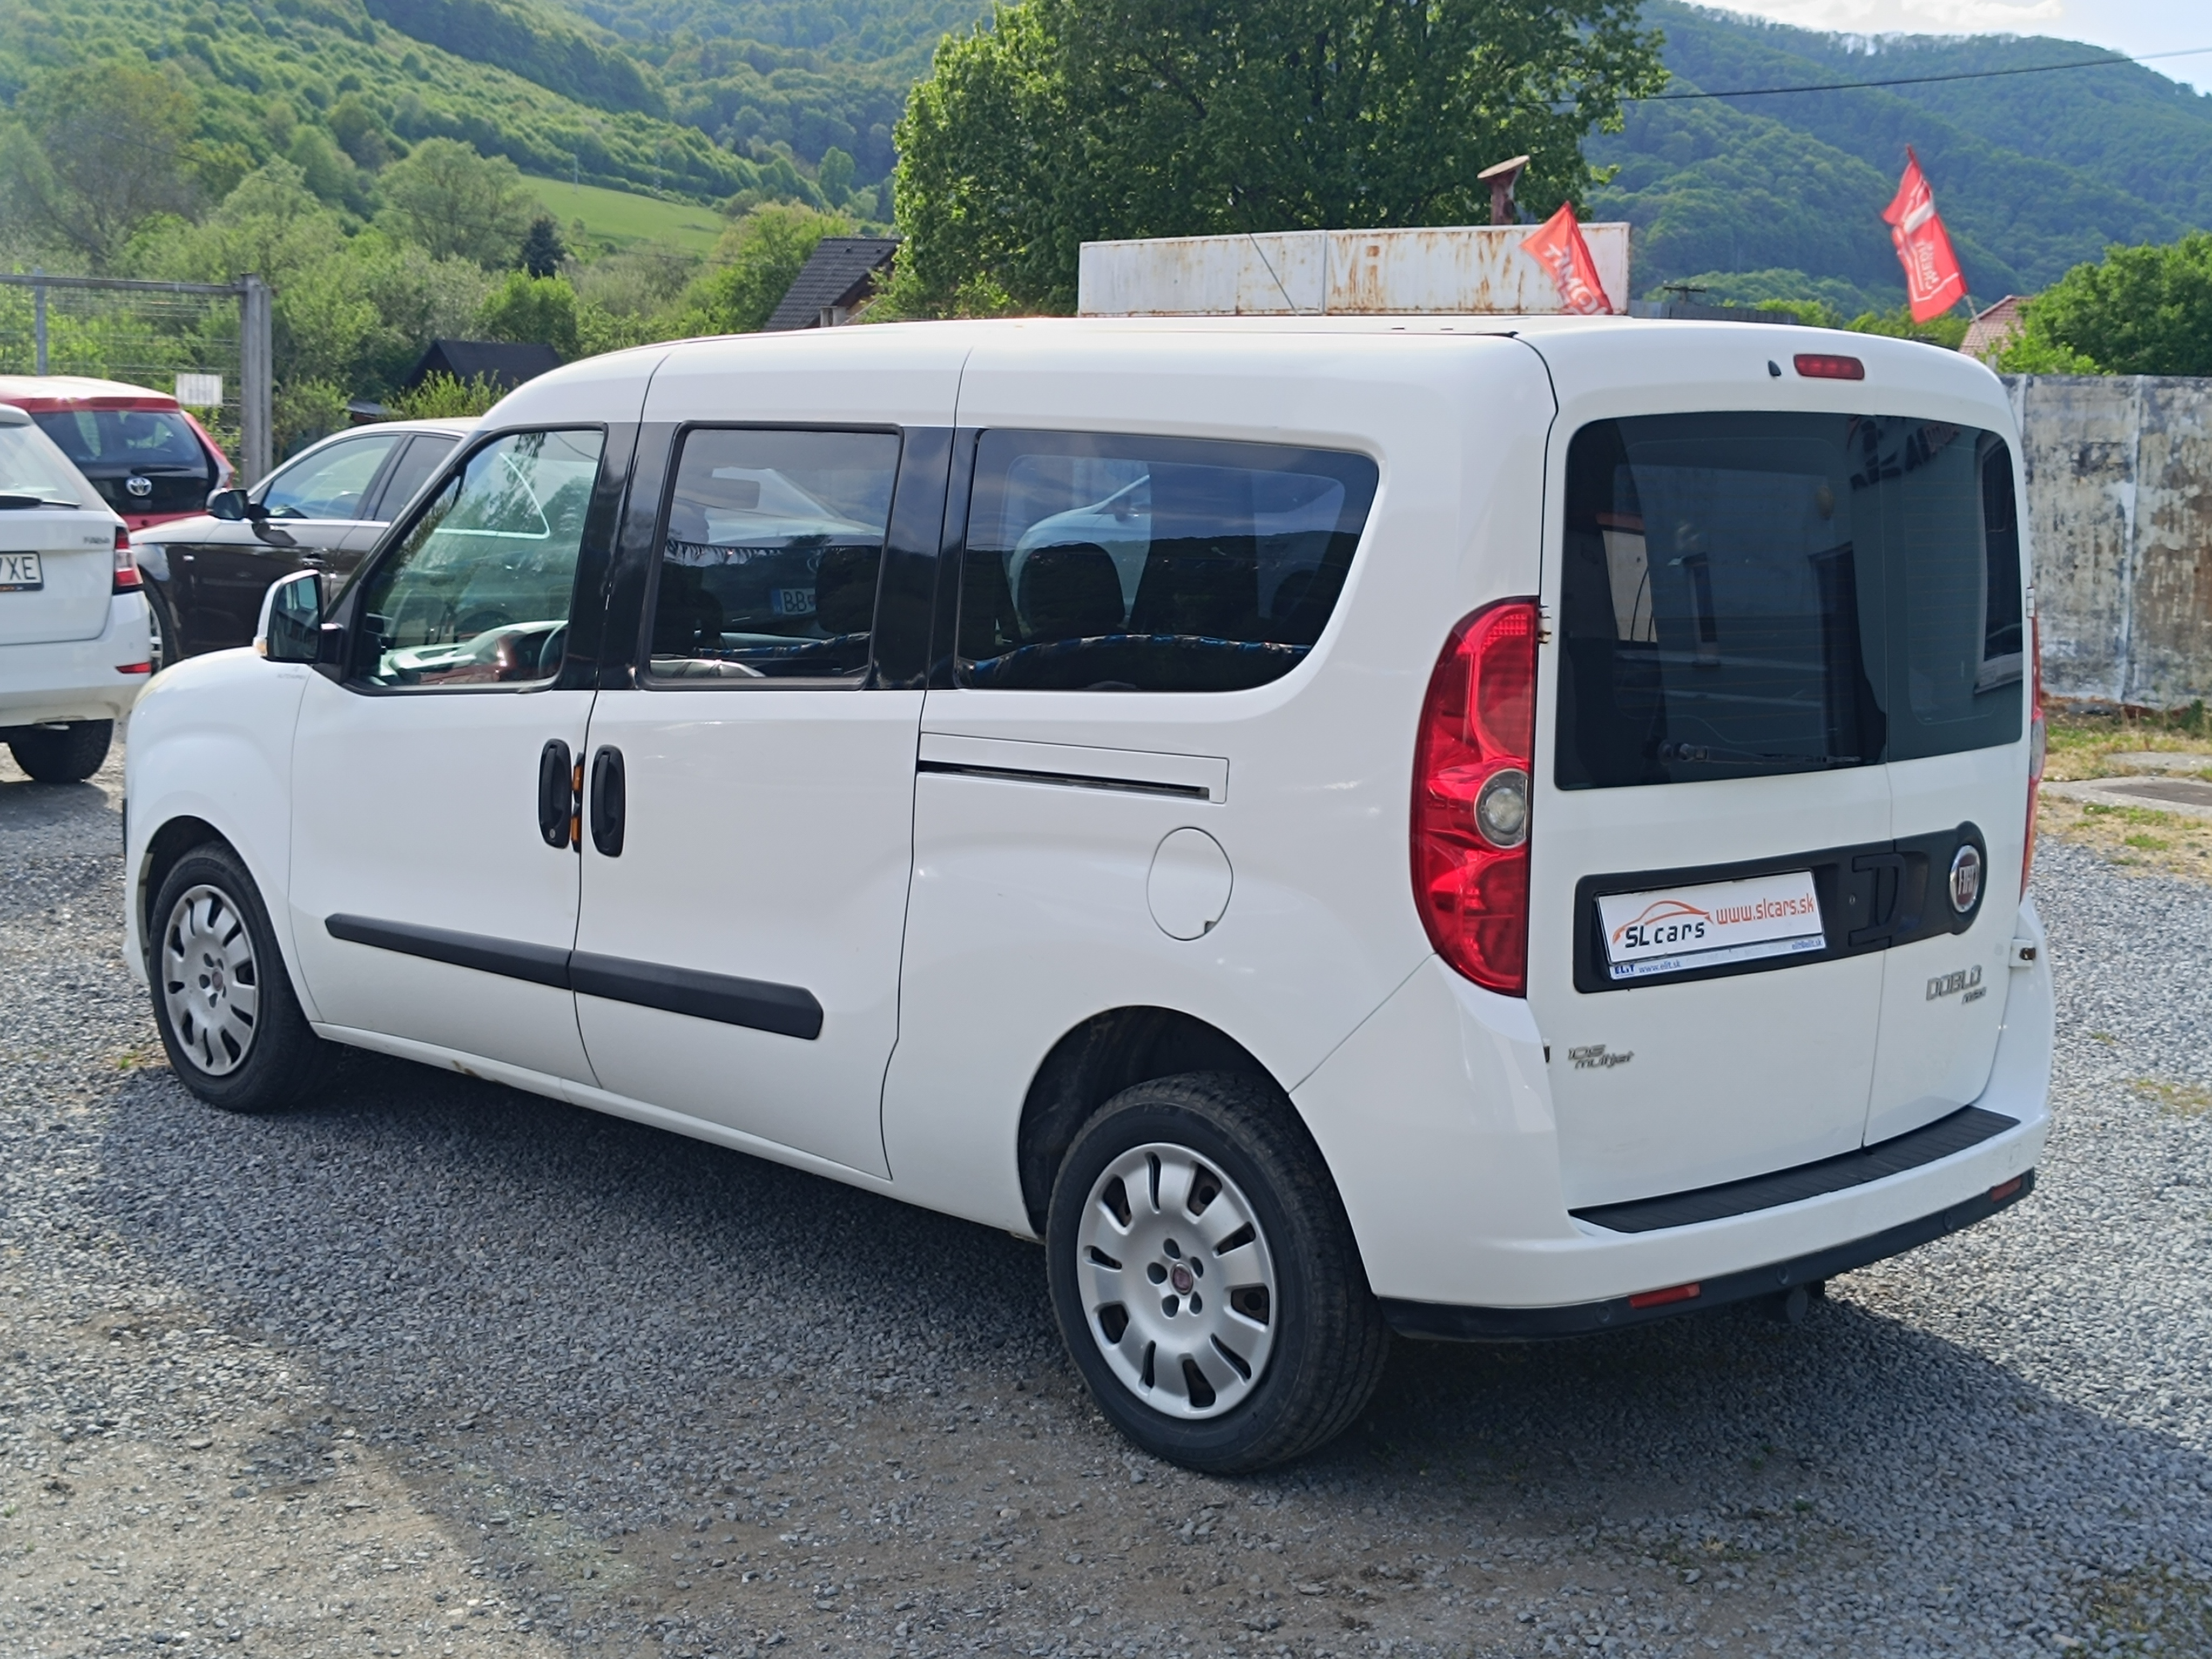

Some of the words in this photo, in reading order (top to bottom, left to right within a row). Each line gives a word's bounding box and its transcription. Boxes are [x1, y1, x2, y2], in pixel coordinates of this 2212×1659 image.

[0, 557, 37, 581] XE
[1957, 864, 1979, 895] FIAT
[1716, 893, 1814, 925] www.slcars.sk
